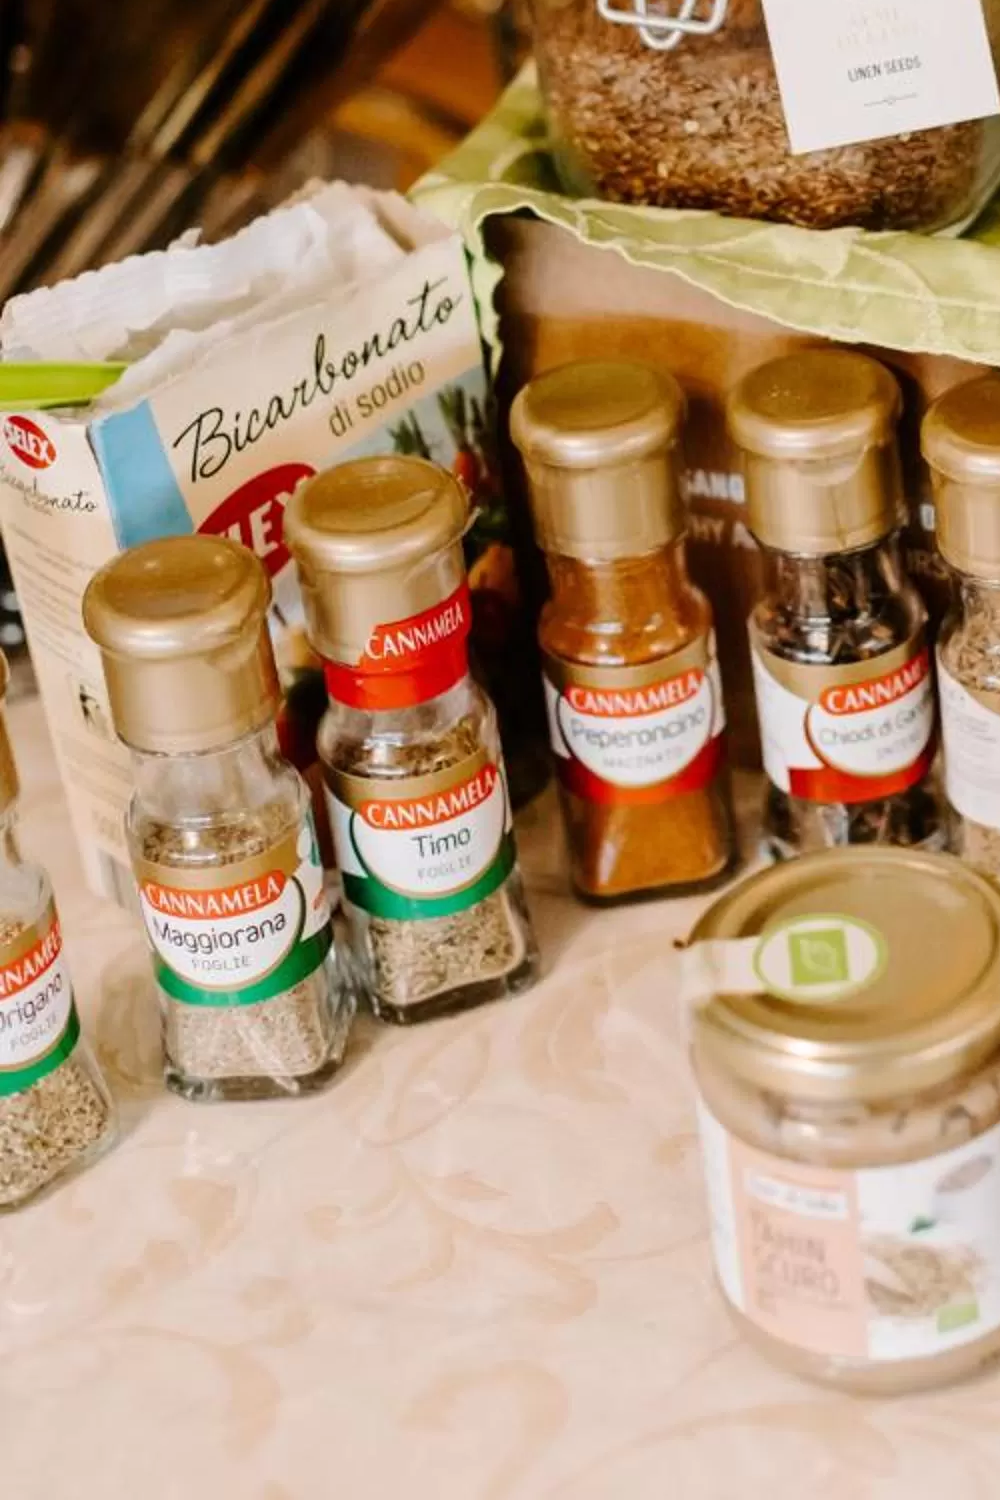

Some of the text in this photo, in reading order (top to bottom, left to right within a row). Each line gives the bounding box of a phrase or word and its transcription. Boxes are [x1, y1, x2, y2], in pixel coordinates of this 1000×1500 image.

[847, 56, 922, 82] LINEN SEEDS
[173, 276, 462, 483] Bicarbonato
[329, 359, 425, 437] di sodio
[364, 601, 464, 660] CANNAMELA
[568, 671, 698, 715] CANNAMELA
[827, 659, 921, 712] CANNAM
[367, 771, 494, 827] CANNAMELA
[412, 826, 471, 859] Timo
[145, 875, 281, 917] CANNAMELA
[151, 911, 287, 955] Maggiorana
